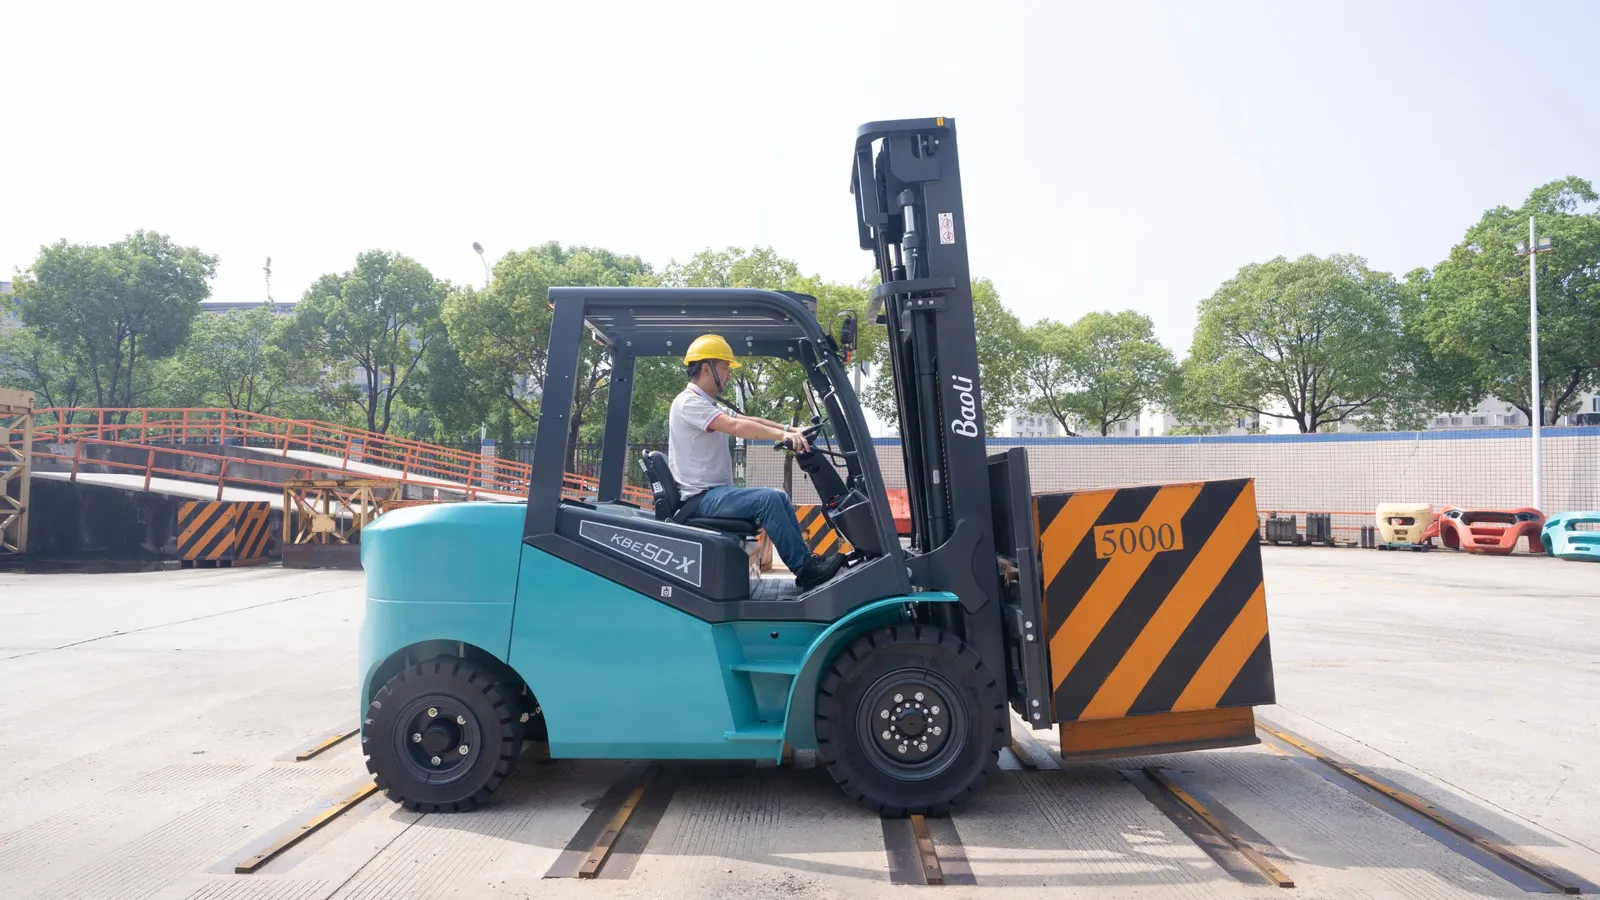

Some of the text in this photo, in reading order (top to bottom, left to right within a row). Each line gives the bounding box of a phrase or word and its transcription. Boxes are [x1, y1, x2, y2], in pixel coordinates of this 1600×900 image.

[951, 374, 979, 438] Baoli
[610, 533, 696, 574] KBE50-X
[1101, 523, 1175, 557] 5000
